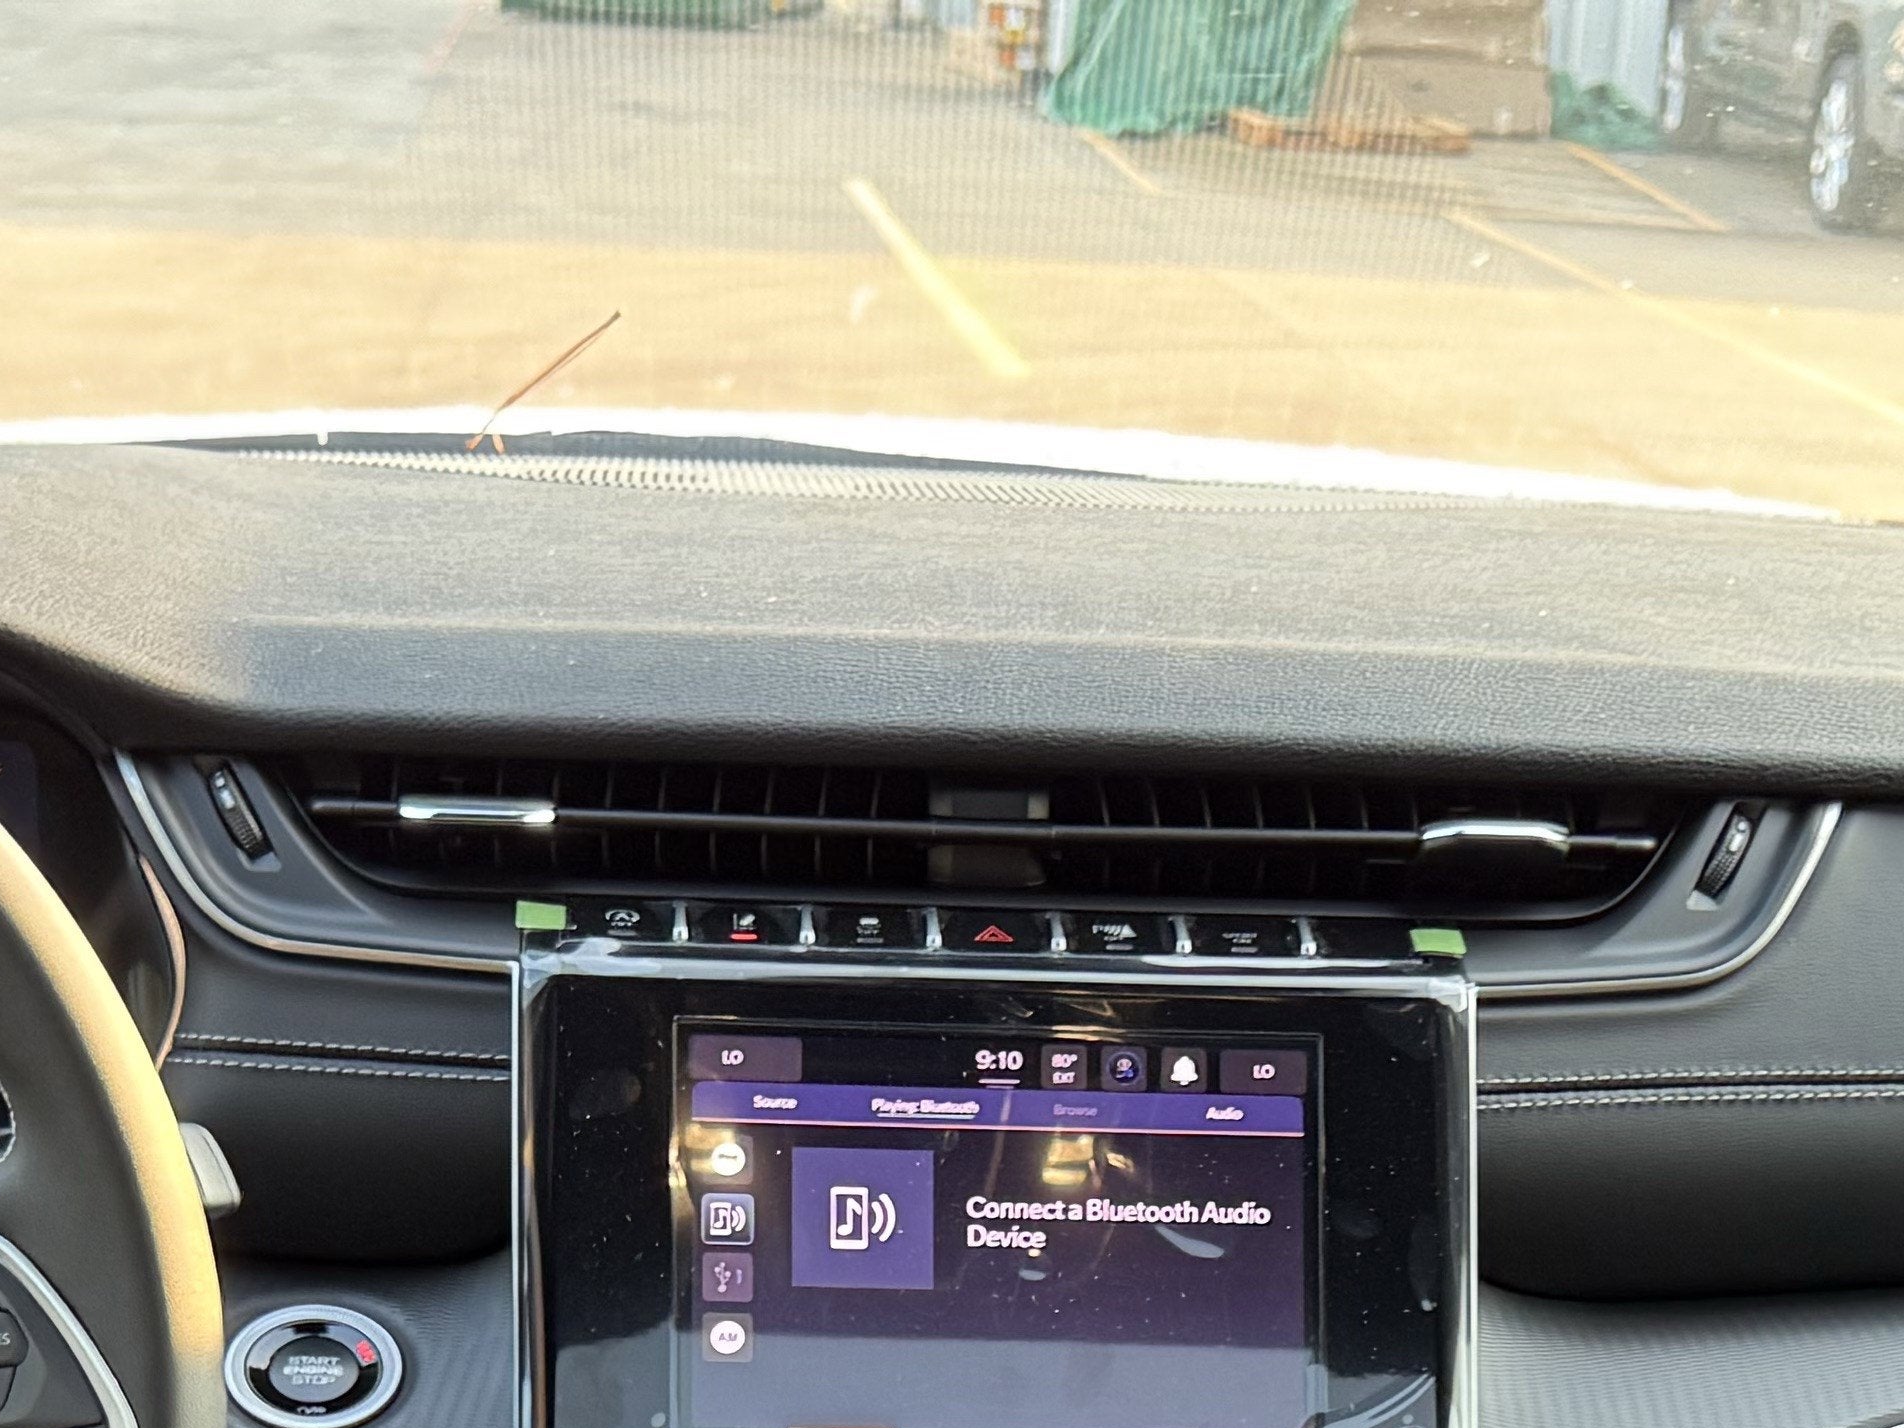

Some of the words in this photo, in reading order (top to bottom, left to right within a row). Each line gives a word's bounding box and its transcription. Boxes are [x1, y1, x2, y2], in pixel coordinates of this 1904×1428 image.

[721, 1050, 744, 1065] LO
[975, 1049, 1024, 1071] 9:10
[1253, 1063, 1276, 1080] LO
[966, 1195, 1066, 1220] Connect
[1067, 1203, 1083, 1221] a
[1085, 1198, 1198, 1223] Bluetooth
[1200, 1200, 1272, 1225] Audio
[967, 1224, 1047, 1249] Device
[288, 1355, 341, 1366] START
